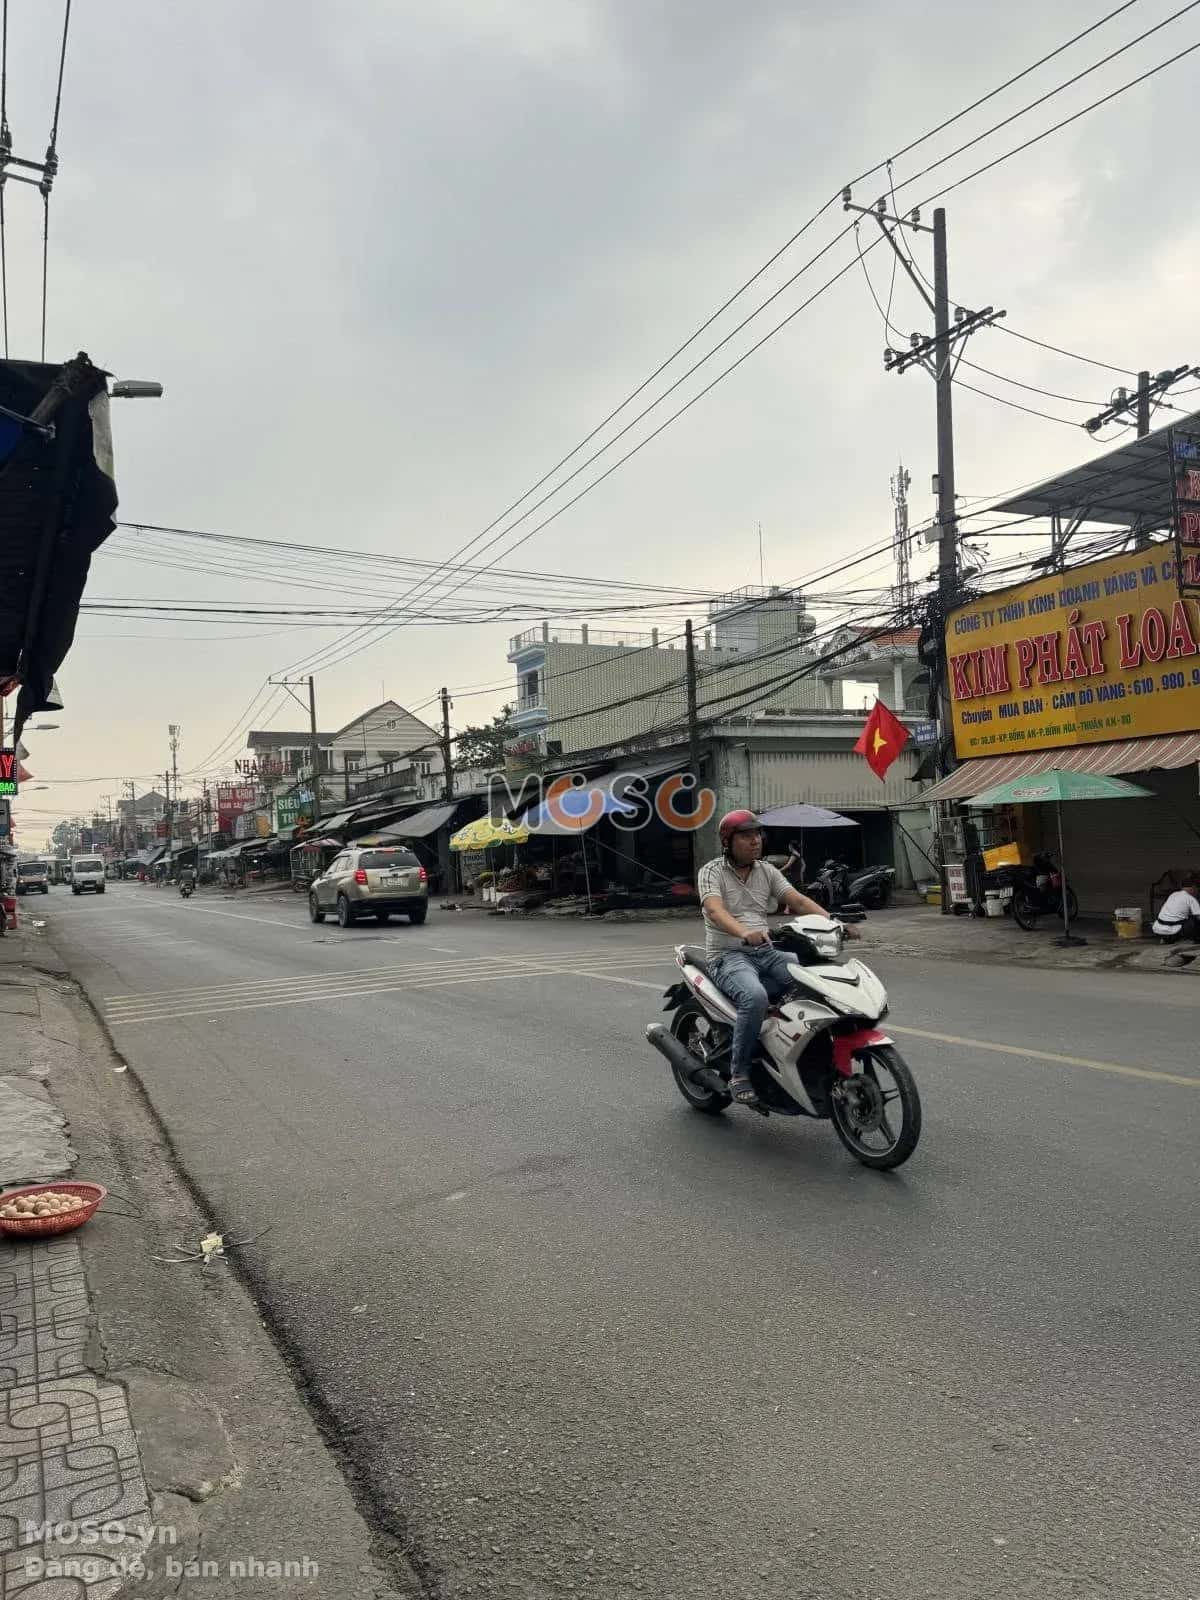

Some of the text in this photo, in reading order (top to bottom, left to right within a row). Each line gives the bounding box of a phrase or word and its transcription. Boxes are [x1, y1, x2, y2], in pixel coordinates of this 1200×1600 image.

[954, 613, 980, 635] CÔNG
[982, 609, 994, 628] TY
[997, 601, 1025, 624] TNHH
[1059, 581, 1100, 607] DOANH
[1103, 570, 1137, 596] VÀNG
[1141, 561, 1157, 586] VÀ
[950, 599, 1200, 700] KIM PHÁT LOA
[999, 702, 1020, 718] MUA
[1023, 695, 1043, 714] BÁN
[1096, 681, 1125, 703] VÀNG
[0, 754, 14, 778] Y
